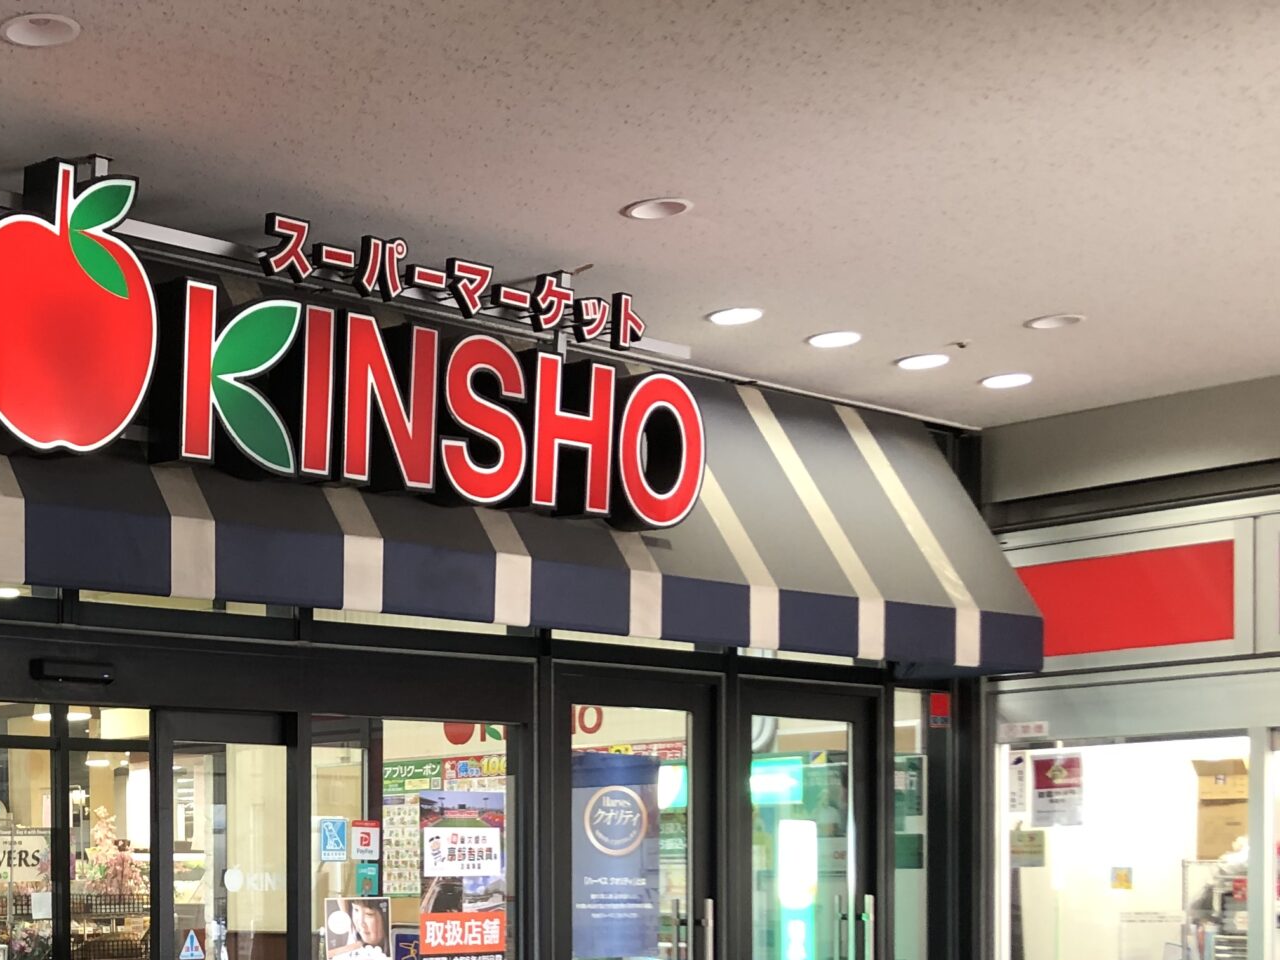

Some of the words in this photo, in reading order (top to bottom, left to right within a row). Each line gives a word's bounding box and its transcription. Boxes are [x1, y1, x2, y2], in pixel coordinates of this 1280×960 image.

[266, 212, 646, 350] スーパーマーケット
[181, 276, 705, 529] KINSHO
[383, 763, 441, 779] アプリクーポン
[593, 808, 641, 826] クオリティ
[425, 918, 501, 947] 取扱店舗
